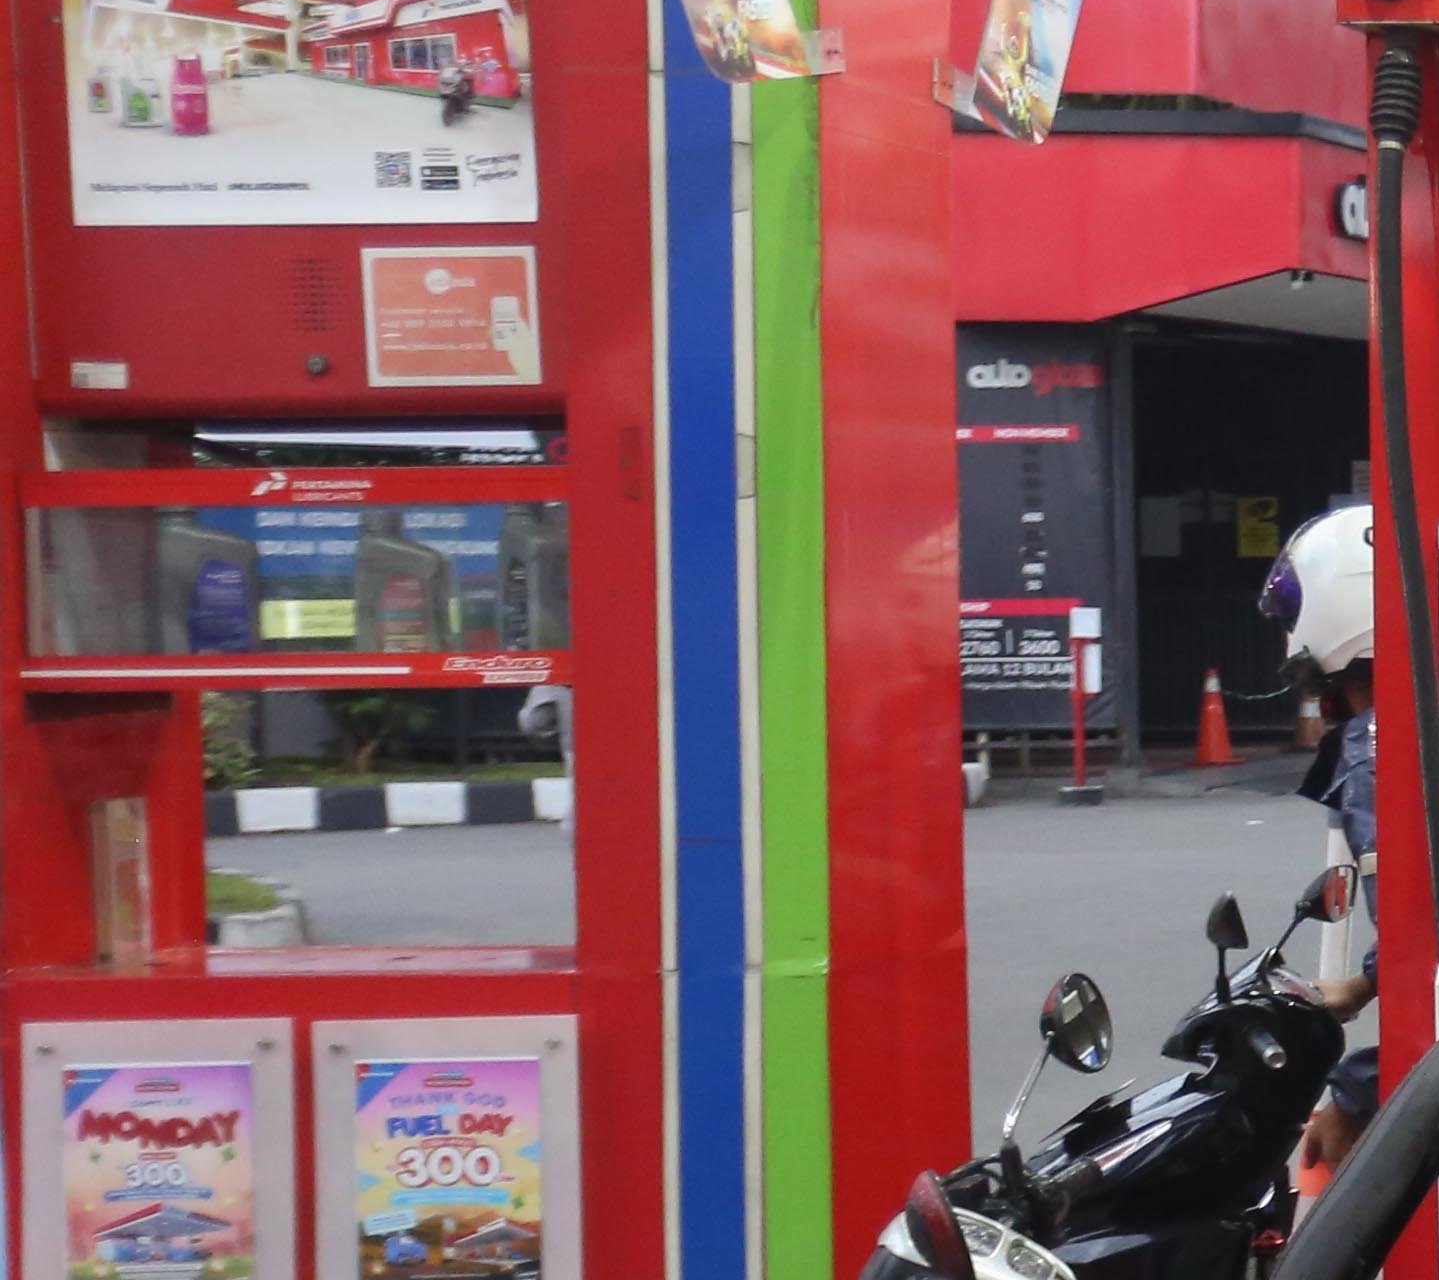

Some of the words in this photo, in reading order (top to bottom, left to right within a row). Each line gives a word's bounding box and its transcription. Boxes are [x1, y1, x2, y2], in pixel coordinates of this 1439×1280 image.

[442, 656, 551, 673] Enduro
[390, 1091, 455, 1108] THANK
[462, 1090, 507, 1108] GOD
[76, 1109, 241, 1149] MONDAY
[387, 1114, 450, 1138] FUEL
[458, 1113, 514, 1138] DAY
[396, 1146, 502, 1188] 300
